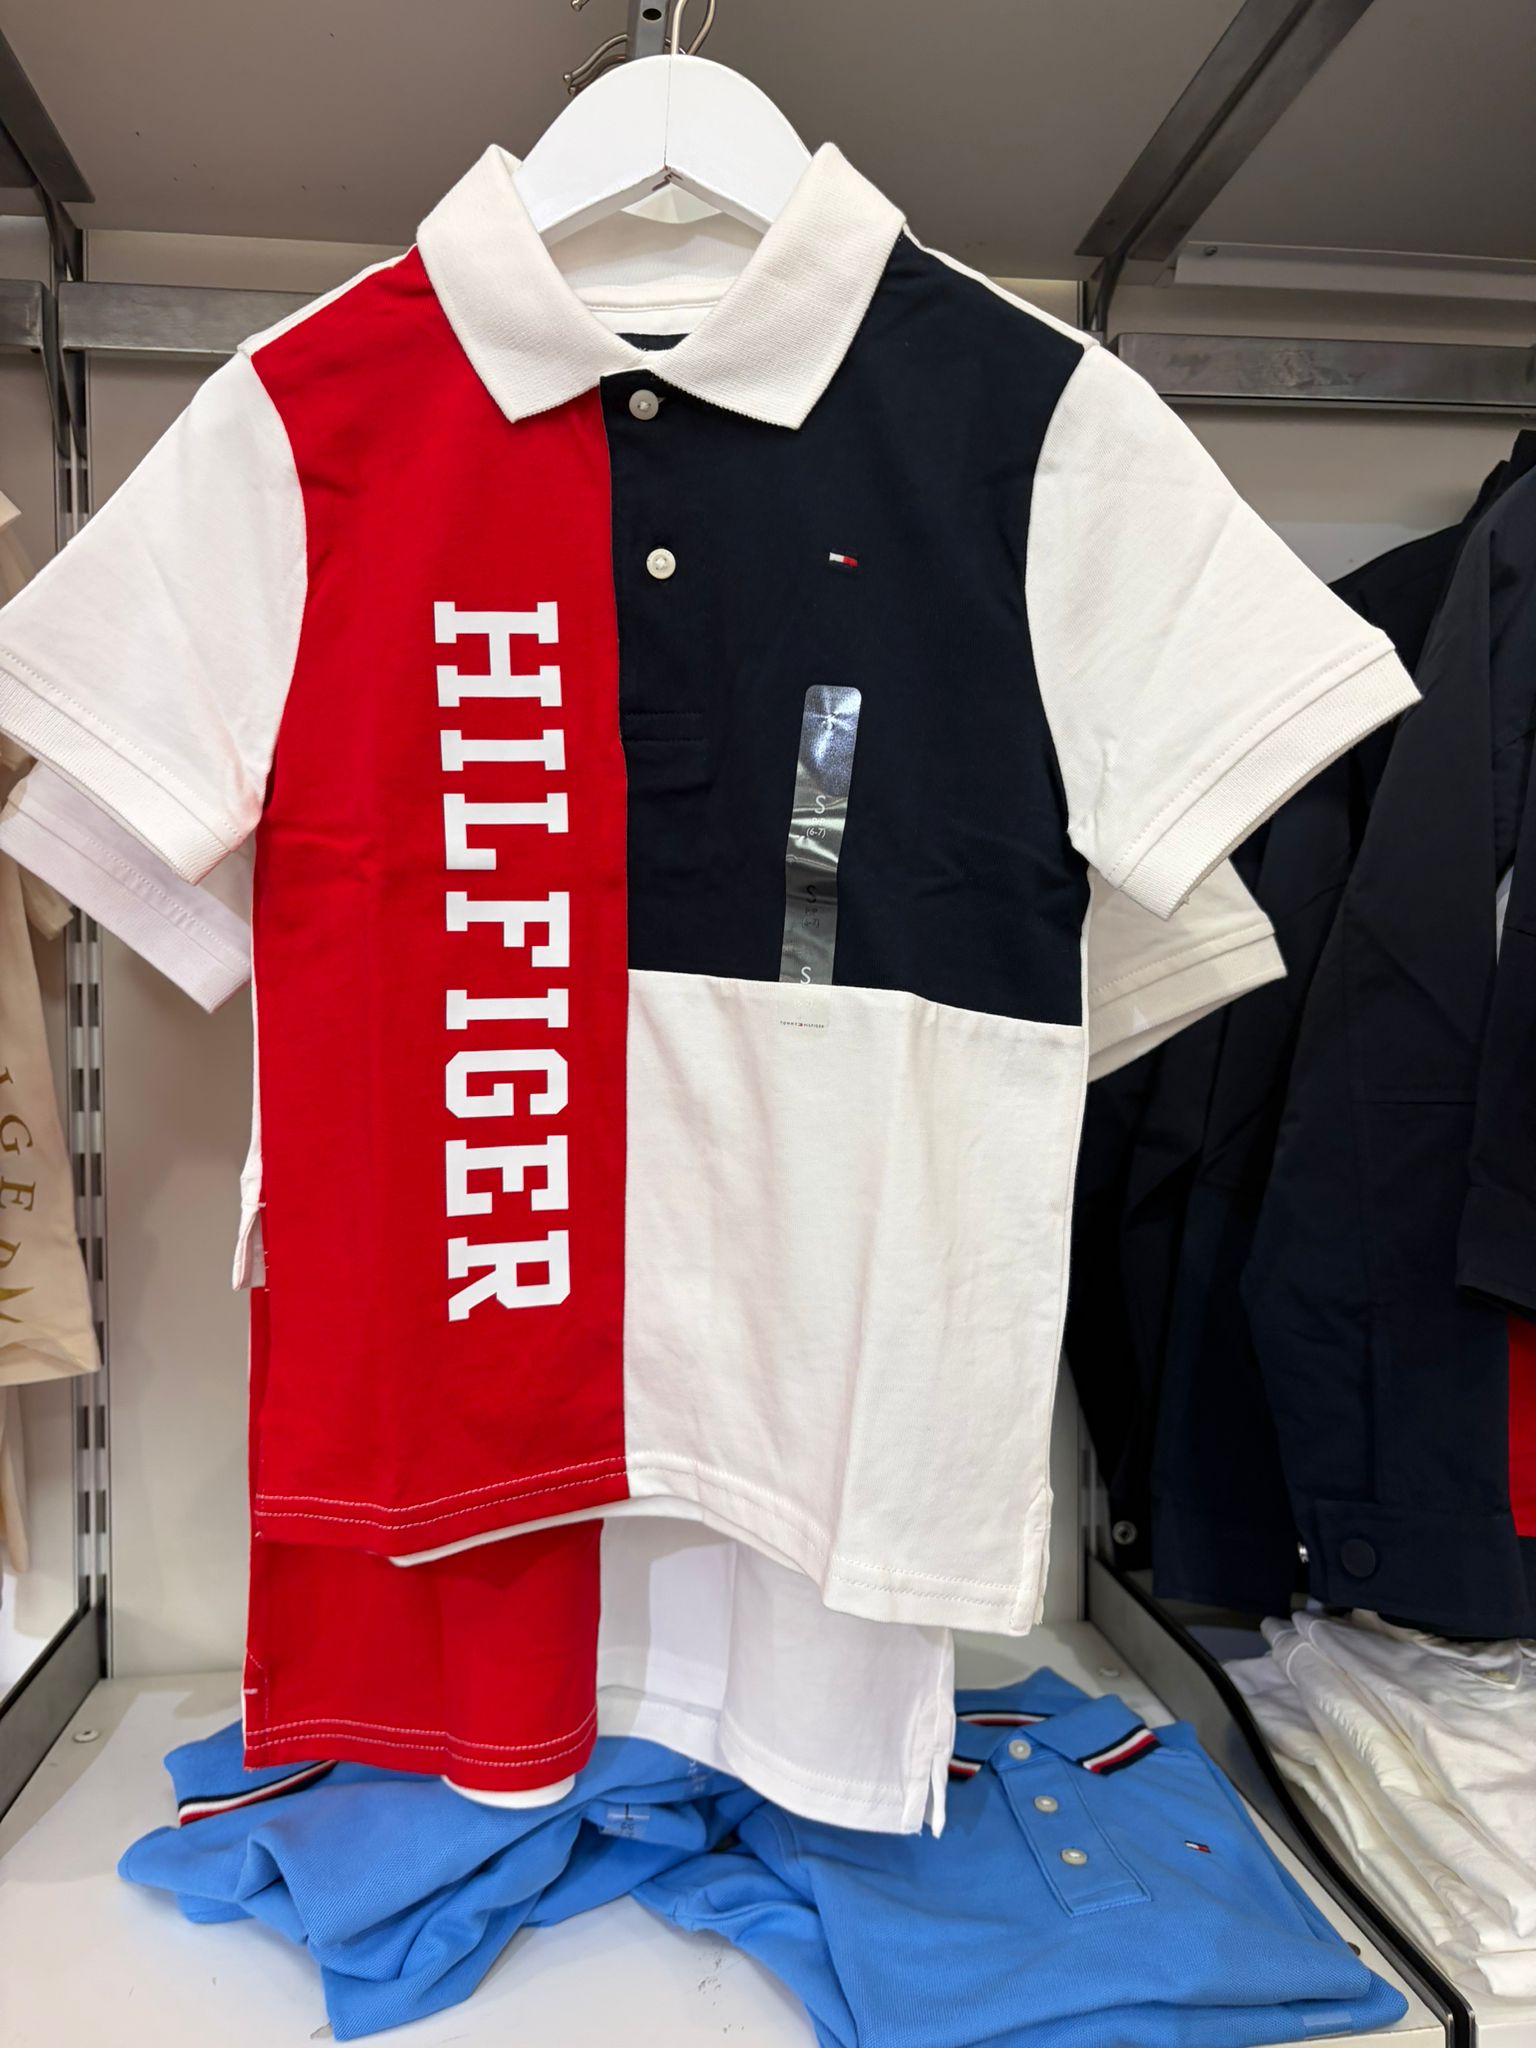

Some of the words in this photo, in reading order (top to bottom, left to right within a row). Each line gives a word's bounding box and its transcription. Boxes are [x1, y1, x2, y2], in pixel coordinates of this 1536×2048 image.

[814, 794, 826, 814] S
[806, 827, 826, 839] (6-7)
[806, 884, 817, 903] S
[434, 601, 571, 1321] HILFIGER
[800, 966, 812, 985] S
